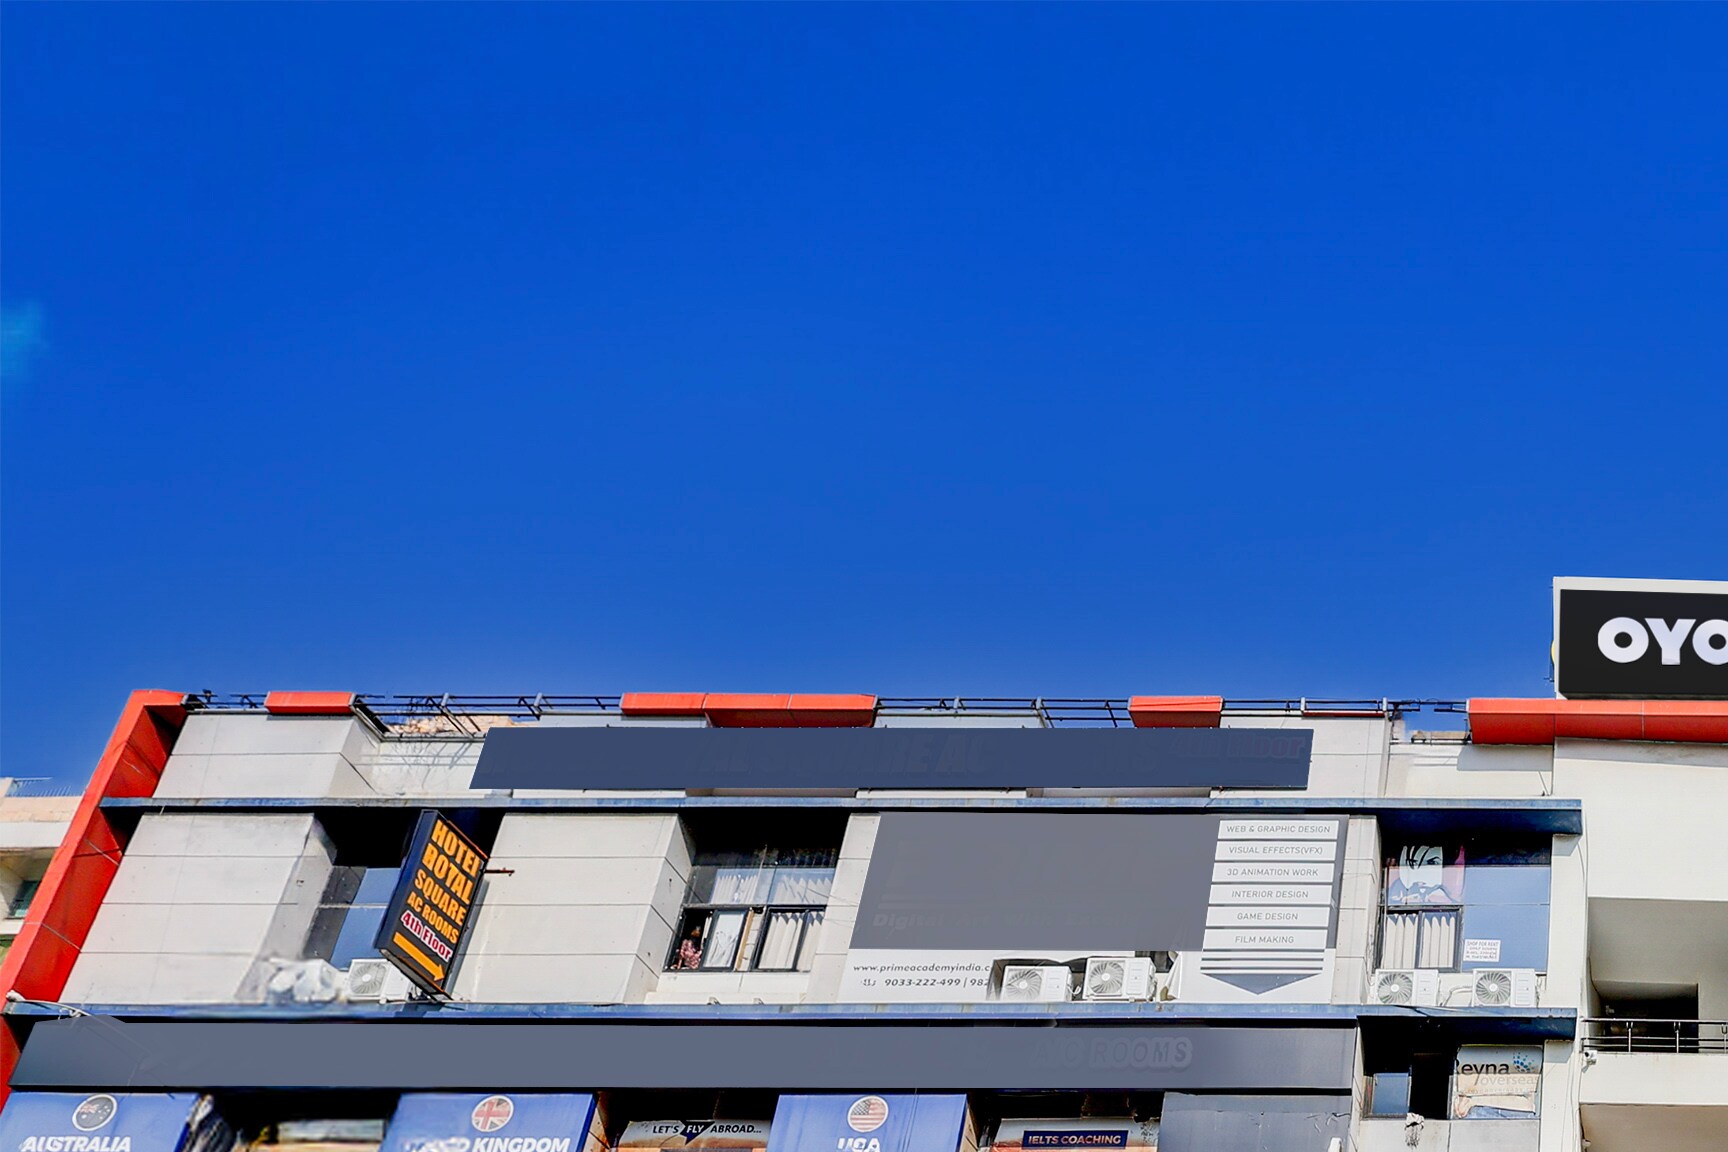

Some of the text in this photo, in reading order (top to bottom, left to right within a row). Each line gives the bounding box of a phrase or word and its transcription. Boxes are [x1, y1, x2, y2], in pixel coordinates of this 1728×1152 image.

[1263, 847, 1322, 855] EFFECTS(VFX)
[422, 843, 474, 905] ROYAL
[415, 869, 466, 926] SQUARE
[408, 892, 460, 944] AC ROOMS
[401, 910, 452, 962] 4th Floor
[19, 1136, 131, 1152] AUSTRALIA
[653, 1125, 762, 1134] LET'S FLY ABROAD...
[1028, 1135, 1121, 1145] IELTS COACHING
